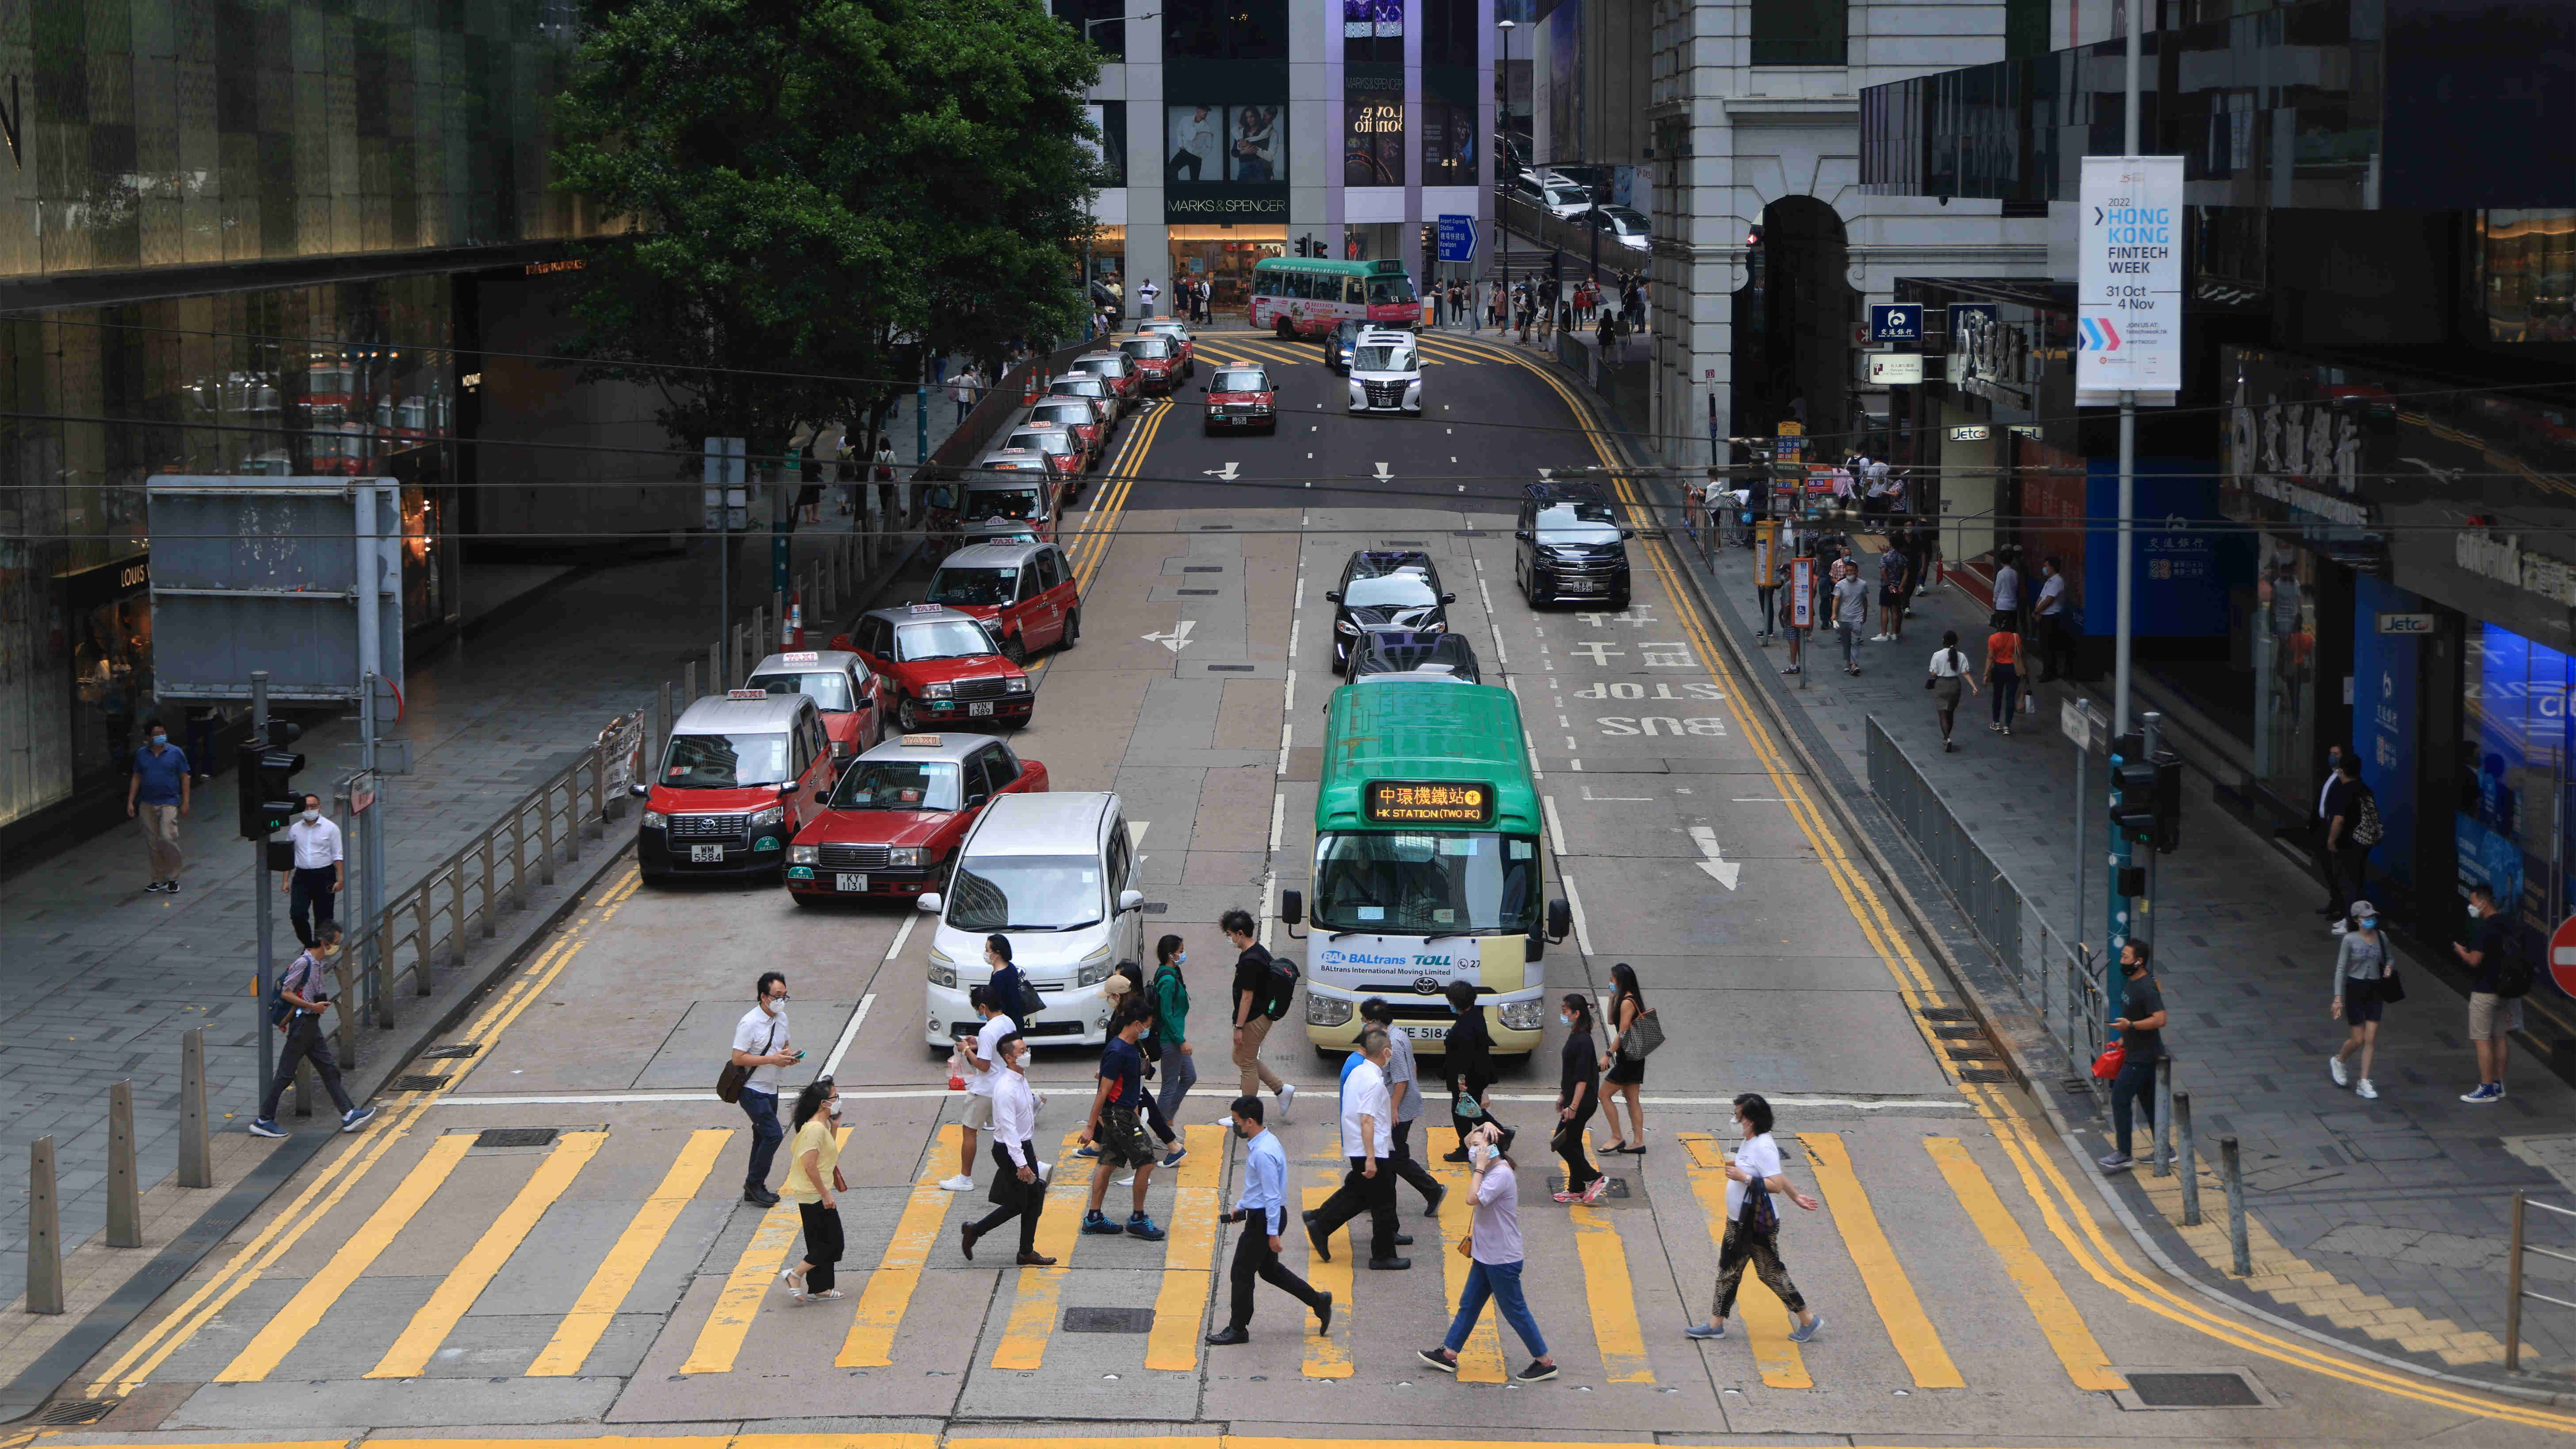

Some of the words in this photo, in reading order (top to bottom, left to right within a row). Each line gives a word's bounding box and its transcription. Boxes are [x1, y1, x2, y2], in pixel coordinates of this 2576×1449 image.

[1168, 200, 1214, 212] MARKS
[1216, 200, 1224, 212] &
[1226, 200, 1286, 212] SPENCER
[2108, 198, 2130, 206] 2022
[2108, 208, 2169, 225] HONG
[2108, 227, 2168, 243] KONG
[2108, 247, 2168, 259] FINTECH
[2108, 262, 2150, 273] WEEK
[2106, 286, 2121, 297] 31
[2123, 286, 2146, 297] Oct
[2118, 299, 2127, 309] 4
[2130, 299, 2155, 309] Nov
[1952, 428, 1987, 439] Jetco
[121, 564, 145, 587] LOUIS
[2384, 617, 2431, 631] Jetco
[1571, 642, 1699, 666] 巴士
[1573, 683, 1726, 699] STOP
[1596, 717, 1727, 736] BUS
[1380, 786, 1465, 805] 中環機鐵站
[1393, 809, 1438, 817] STATION
[1440, 808, 1462, 819] (TWO
[1464, 808, 1479, 819] IFC)
[1349, 953, 1406, 965] BALtrans
[1412, 955, 1451, 966] TOLL
[1321, 965, 1350, 973] BALtrans
[1421, 1028, 1451, 1038] 5184
